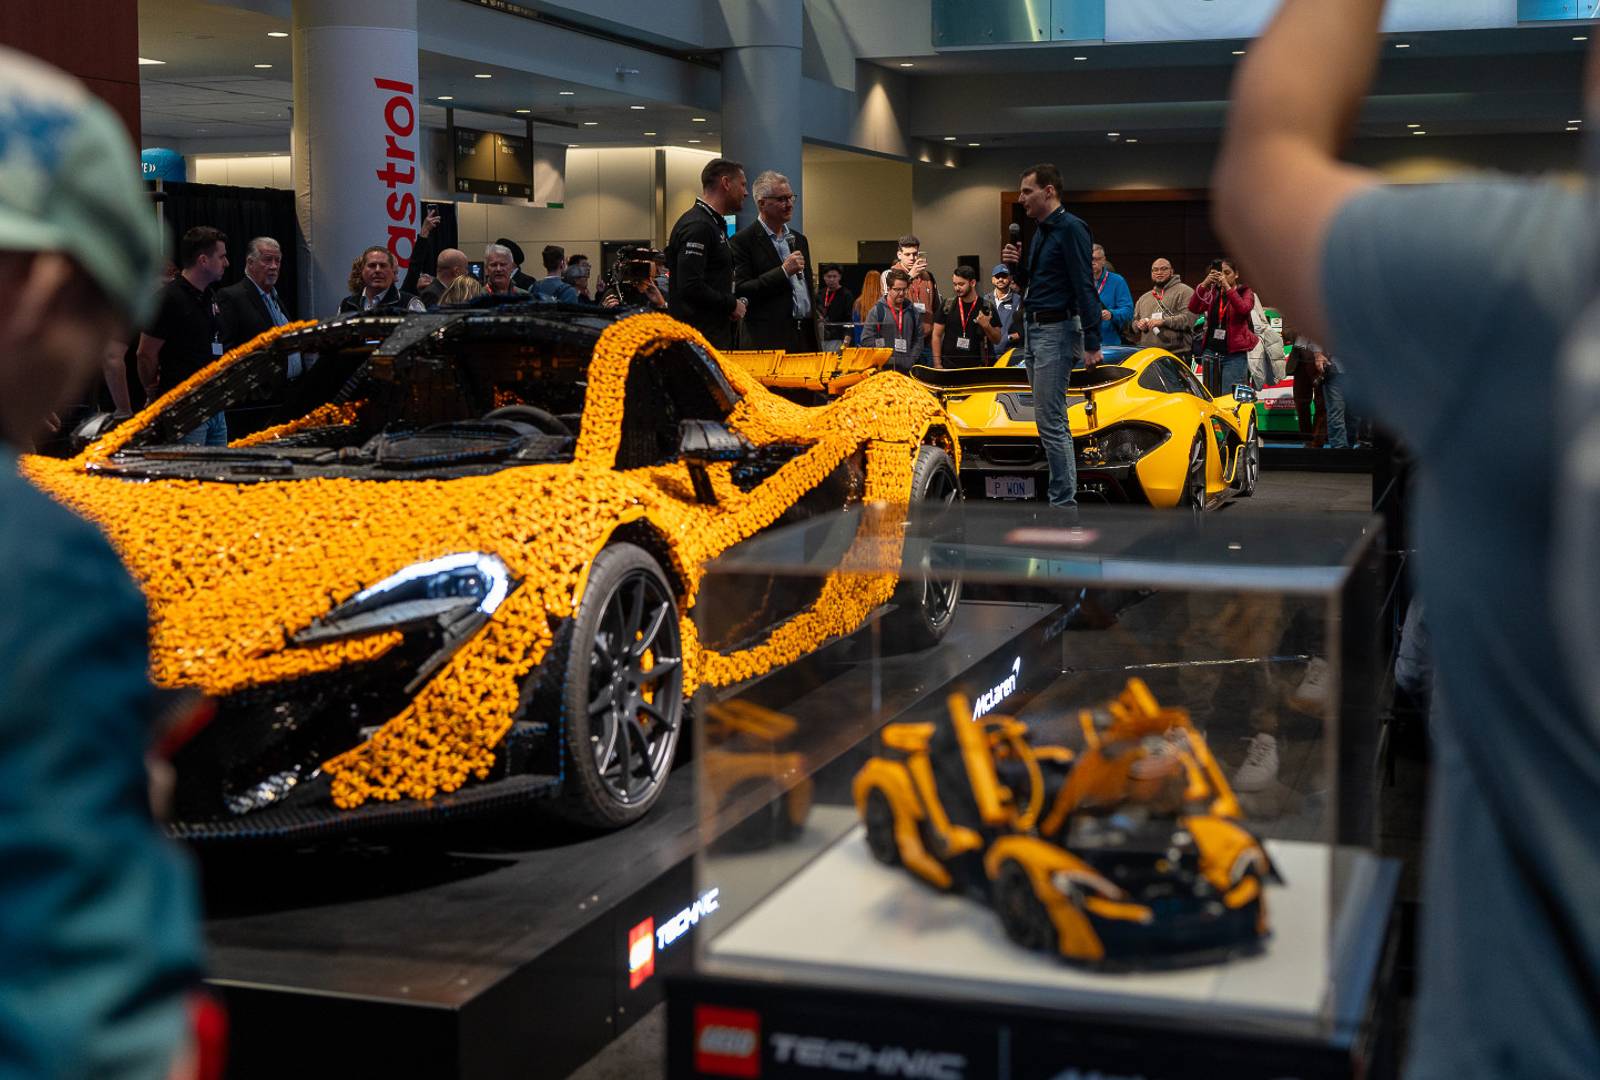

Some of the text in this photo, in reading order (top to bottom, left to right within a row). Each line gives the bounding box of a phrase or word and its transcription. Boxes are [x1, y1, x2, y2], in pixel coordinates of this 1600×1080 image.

[374, 78, 415, 269] astrol
[972, 674, 1016, 721] McLaren
[656, 888, 720, 949] TECHNIC
[770, 1033, 966, 1080] TECHNIC
